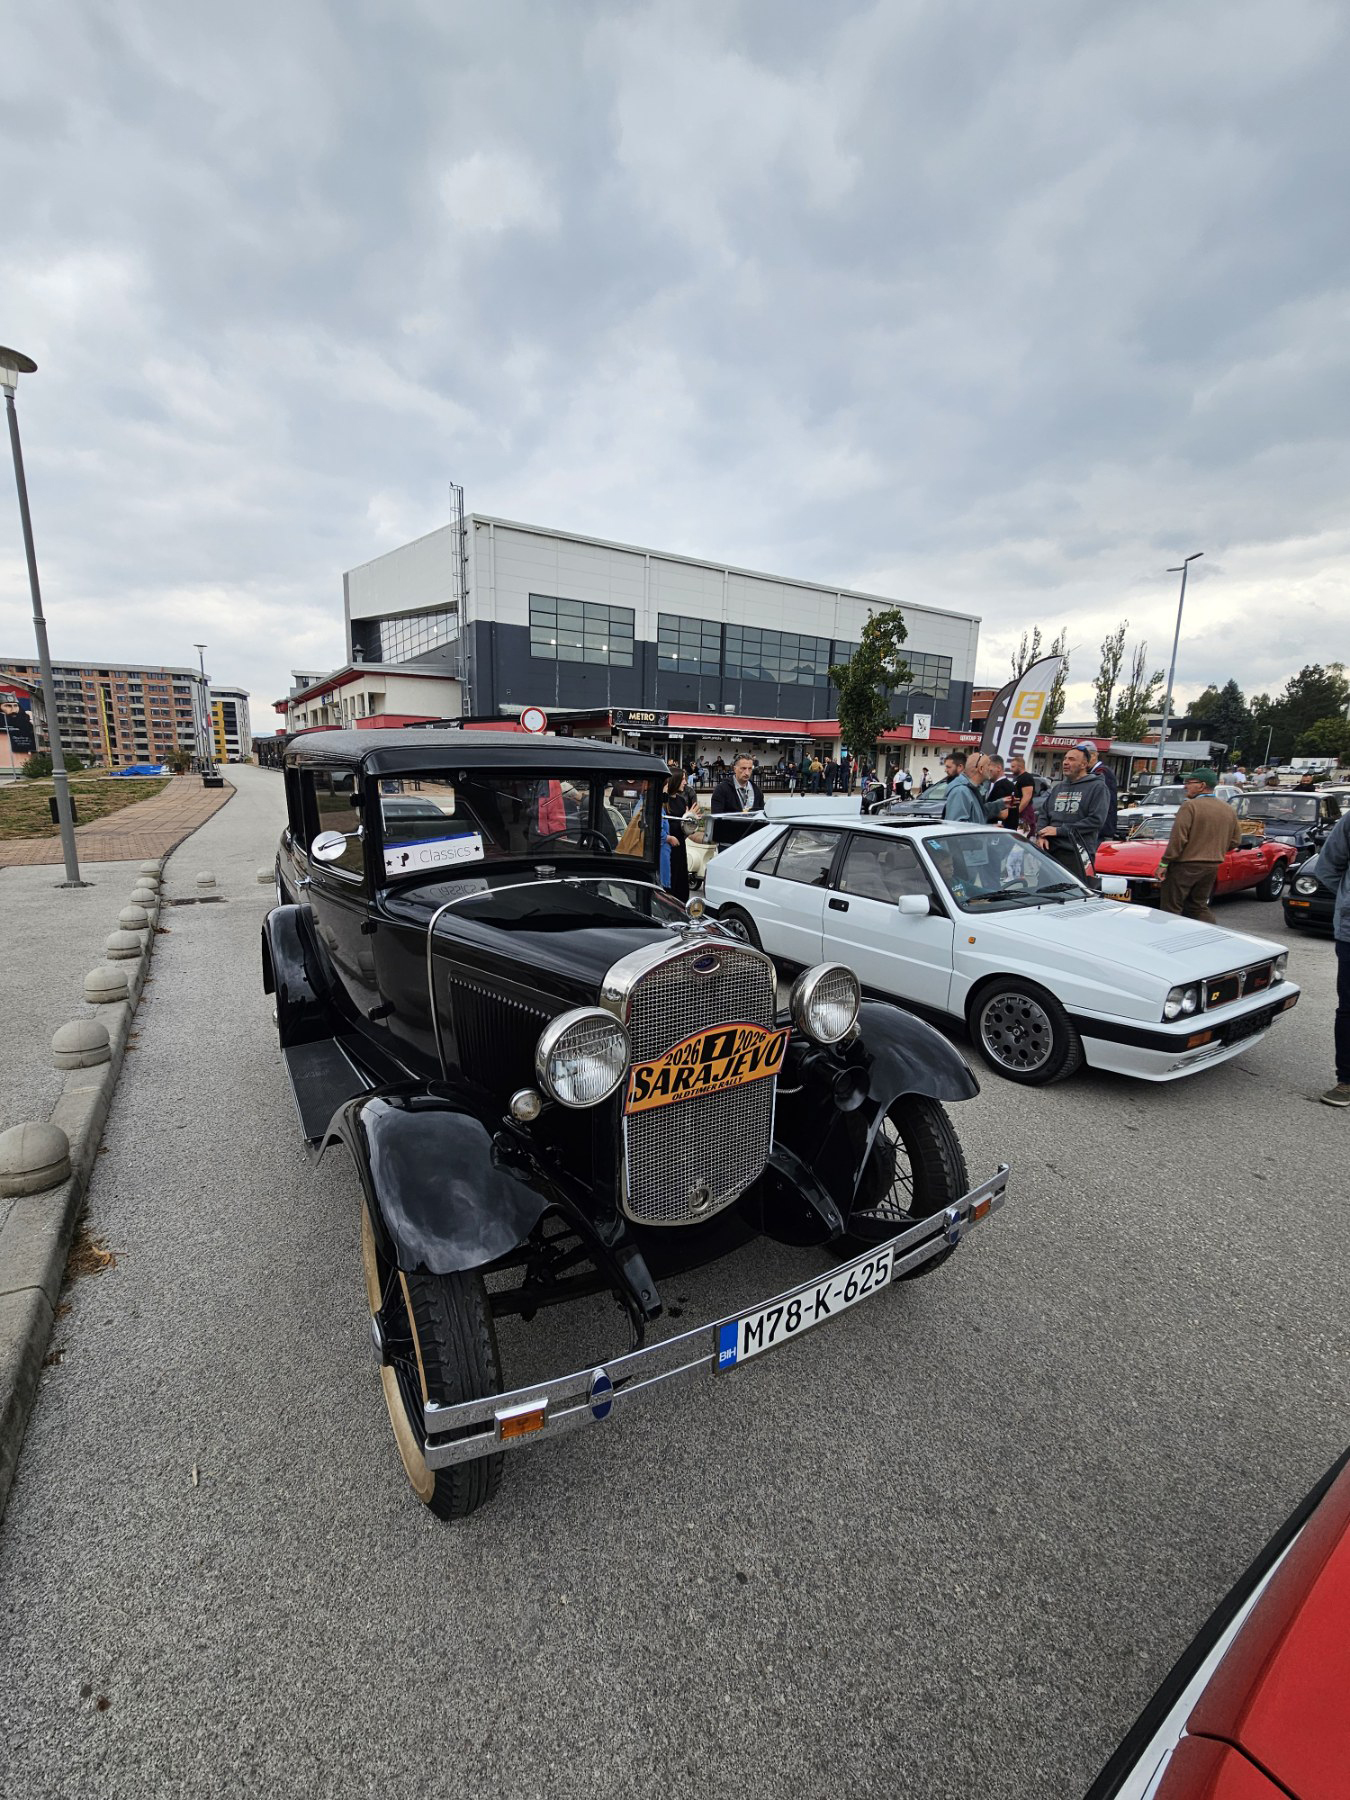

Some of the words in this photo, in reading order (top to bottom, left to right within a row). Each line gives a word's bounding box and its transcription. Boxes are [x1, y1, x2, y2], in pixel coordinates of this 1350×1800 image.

[628, 711, 655, 722] METRO
[419, 846, 471, 863] Classics
[663, 1038, 701, 1067] 2026
[712, 1034, 724, 1060] 1
[733, 1029, 767, 1055] 2026
[628, 1031, 788, 1103] SARAJEVO
[672, 1083, 717, 1101] OLDTIMER
[718, 1076, 744, 1089] RALLY
[719, 1346, 736, 1362] BIH
[743, 1252, 890, 1354] M78-K-625
